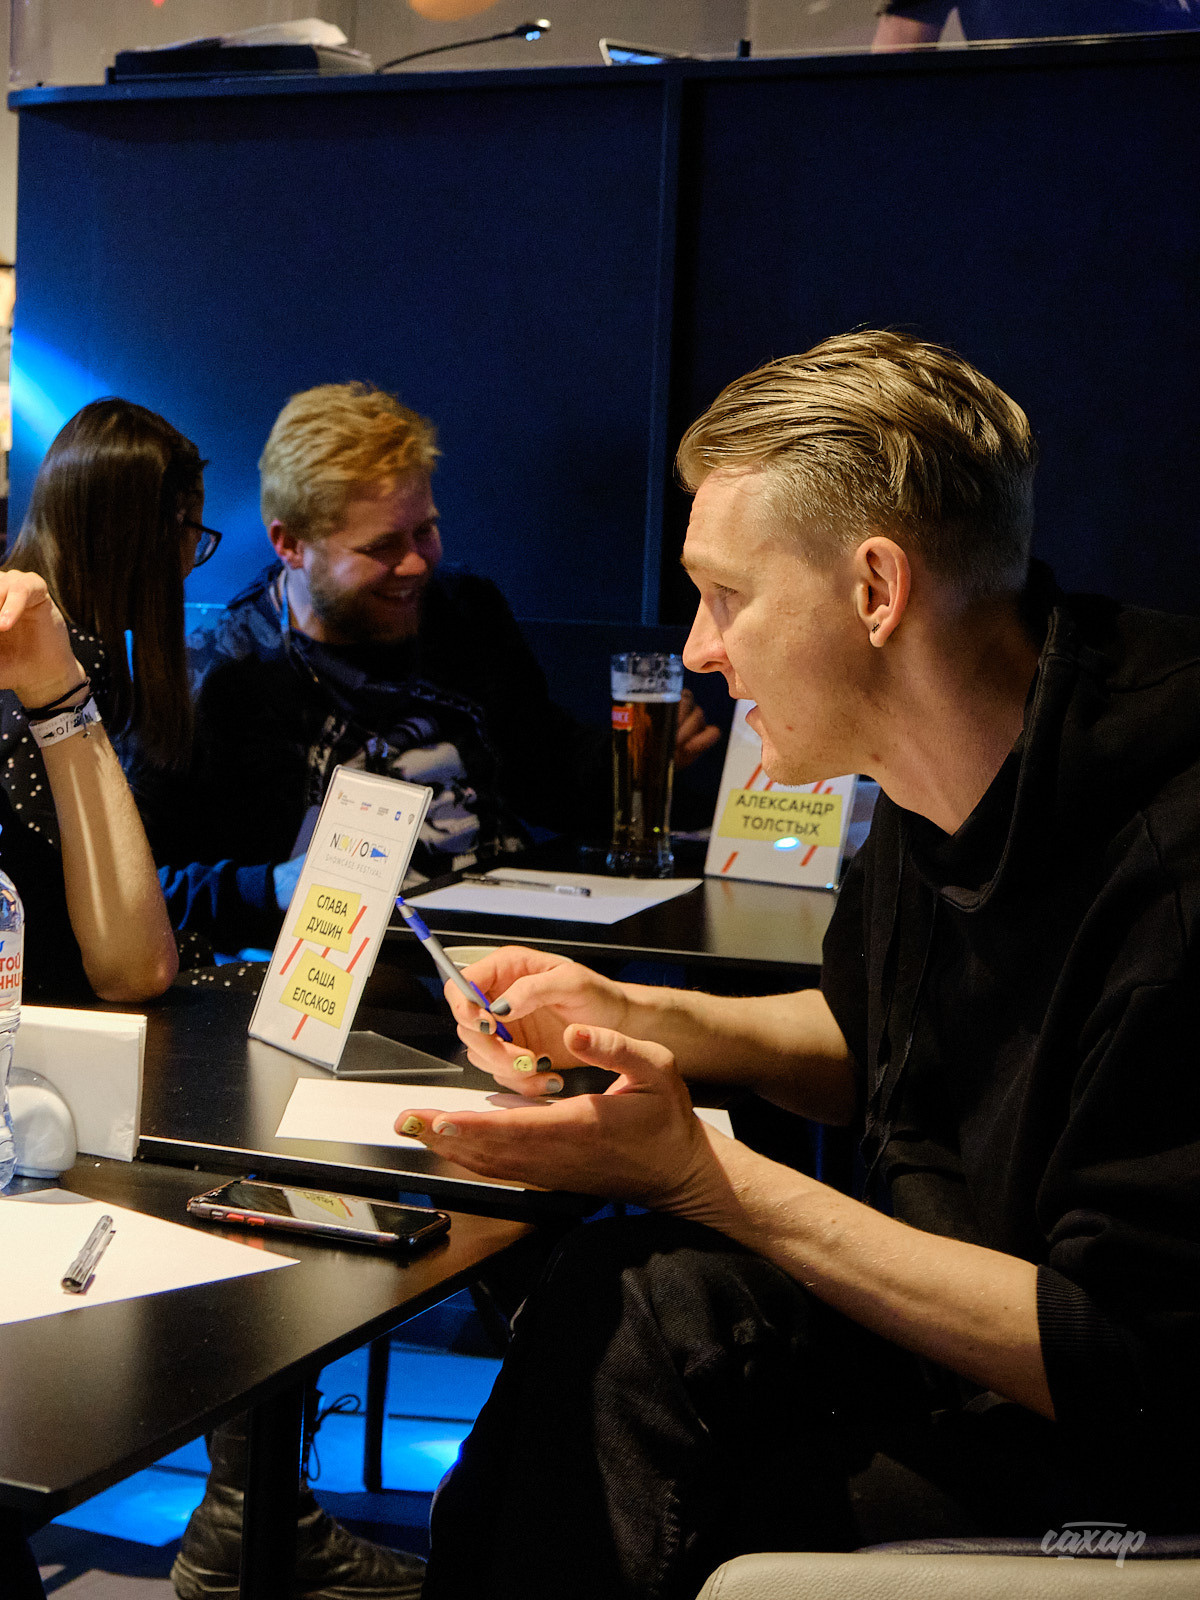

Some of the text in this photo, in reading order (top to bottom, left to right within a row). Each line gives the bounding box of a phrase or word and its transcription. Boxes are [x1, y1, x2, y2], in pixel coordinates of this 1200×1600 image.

[736, 795, 835, 816] АЛЕКСАНДР
[742, 815, 821, 836] ТОЛСТЫХ
[316, 894, 348, 917] СЛАВА
[305, 916, 344, 940] ДУШИН
[307, 967, 336, 990] САША
[292, 986, 336, 1015] ЕЛСАКОВ
